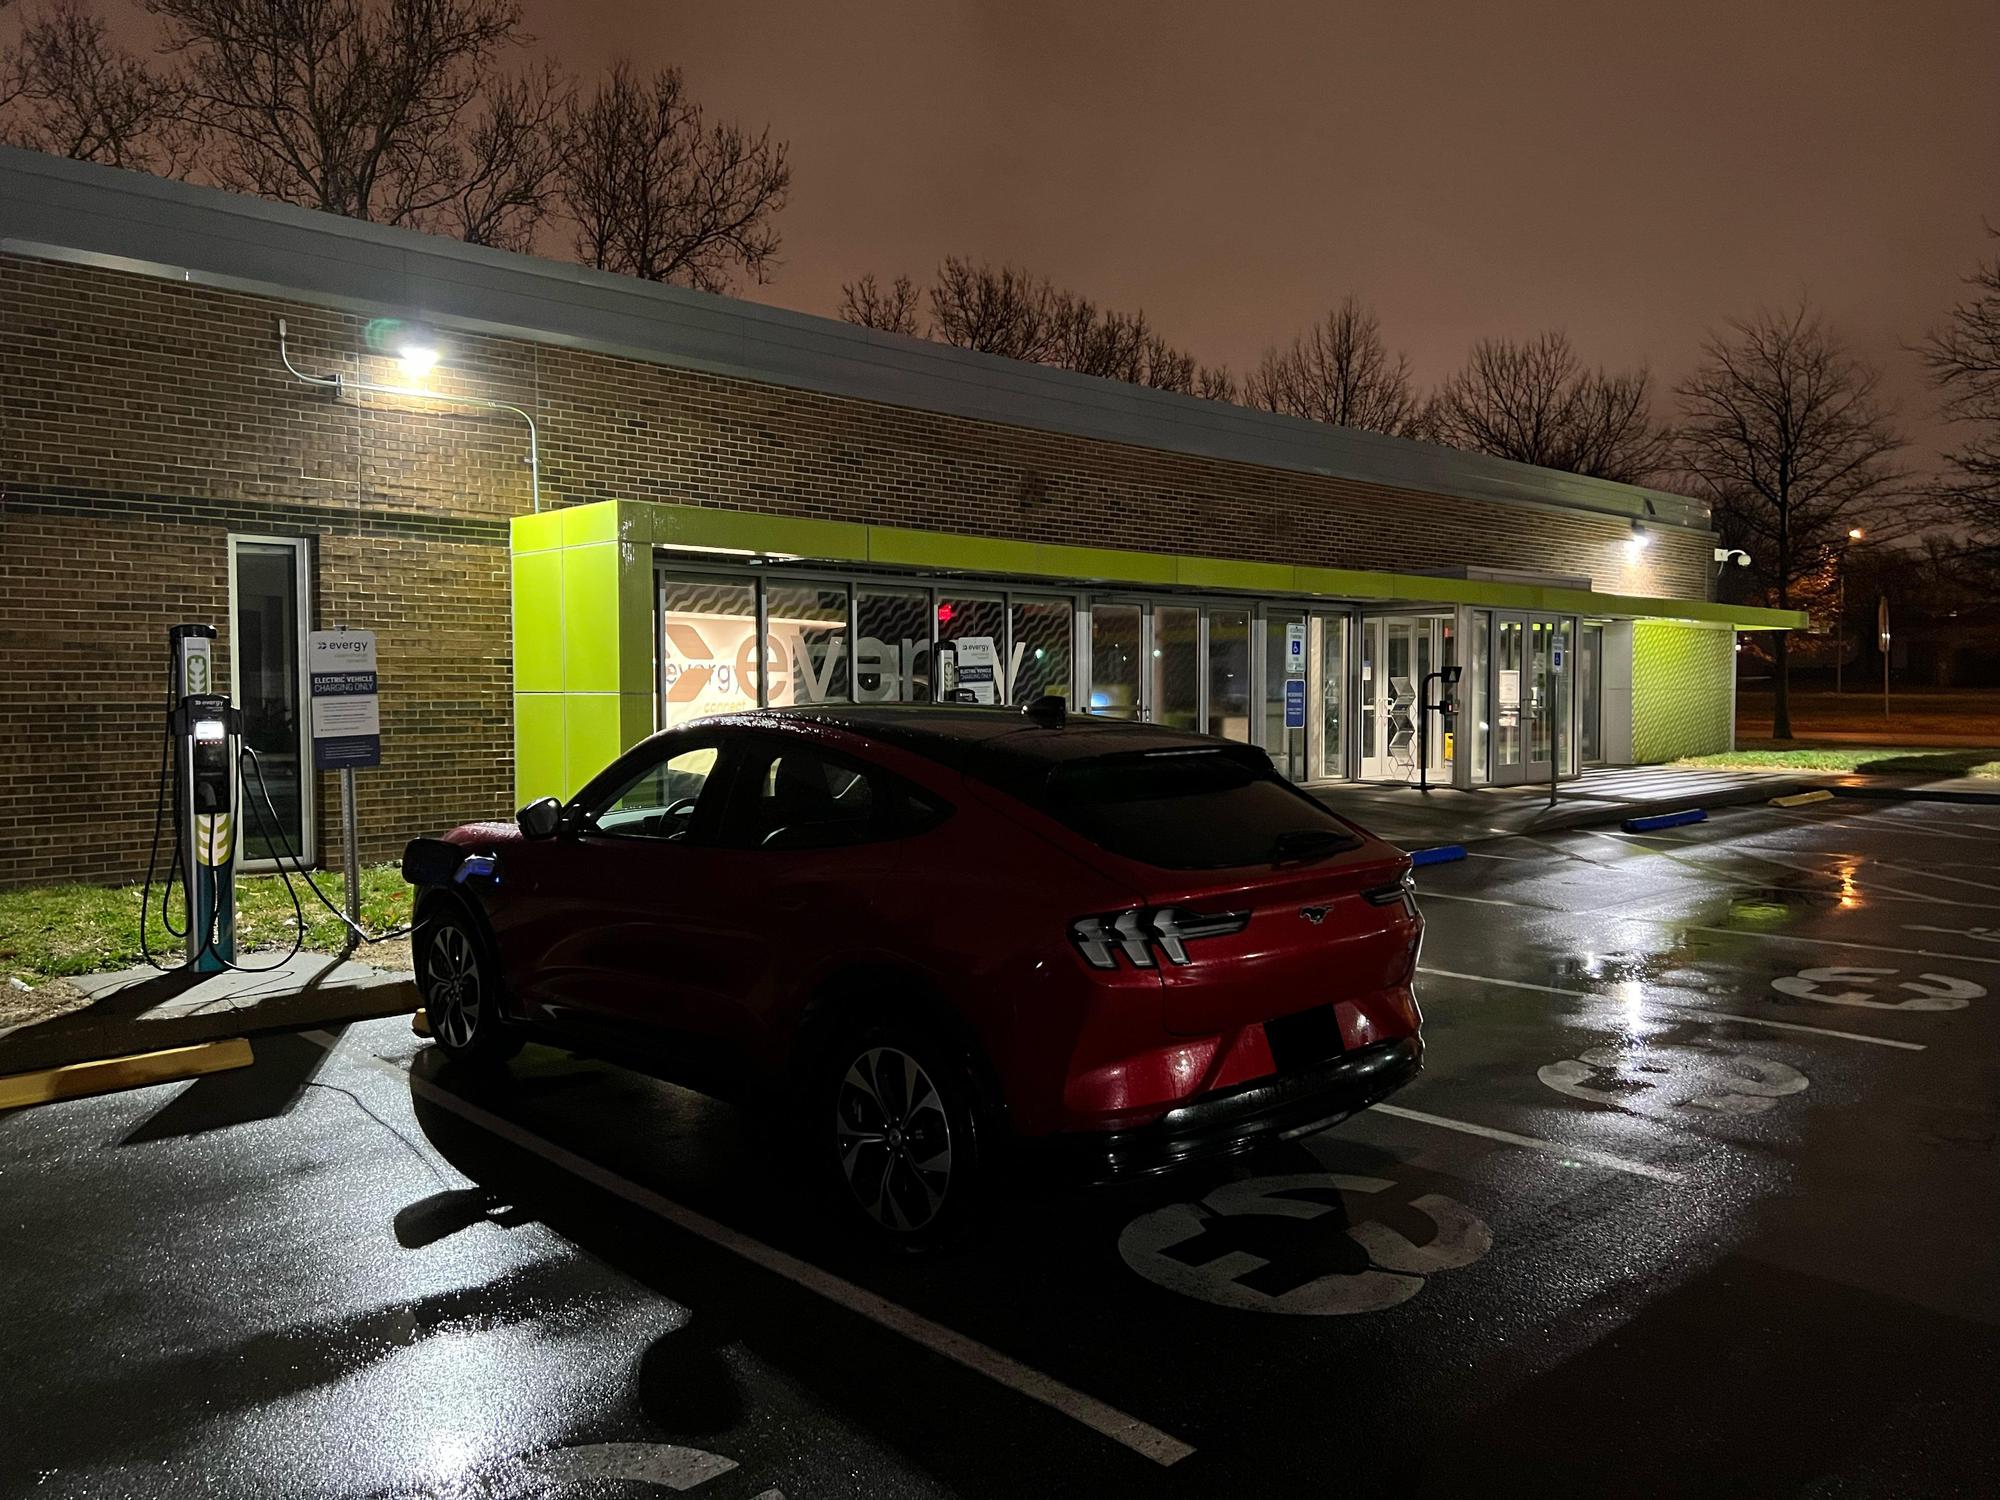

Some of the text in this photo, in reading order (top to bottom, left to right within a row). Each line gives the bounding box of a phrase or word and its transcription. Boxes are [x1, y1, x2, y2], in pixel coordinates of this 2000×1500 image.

[329, 641, 368, 652] evergy
[735, 632, 1026, 703] every
[314, 675, 374, 684] ELECTRIC VEHICLE
[314, 681, 374, 692] CHARGING ONLY
